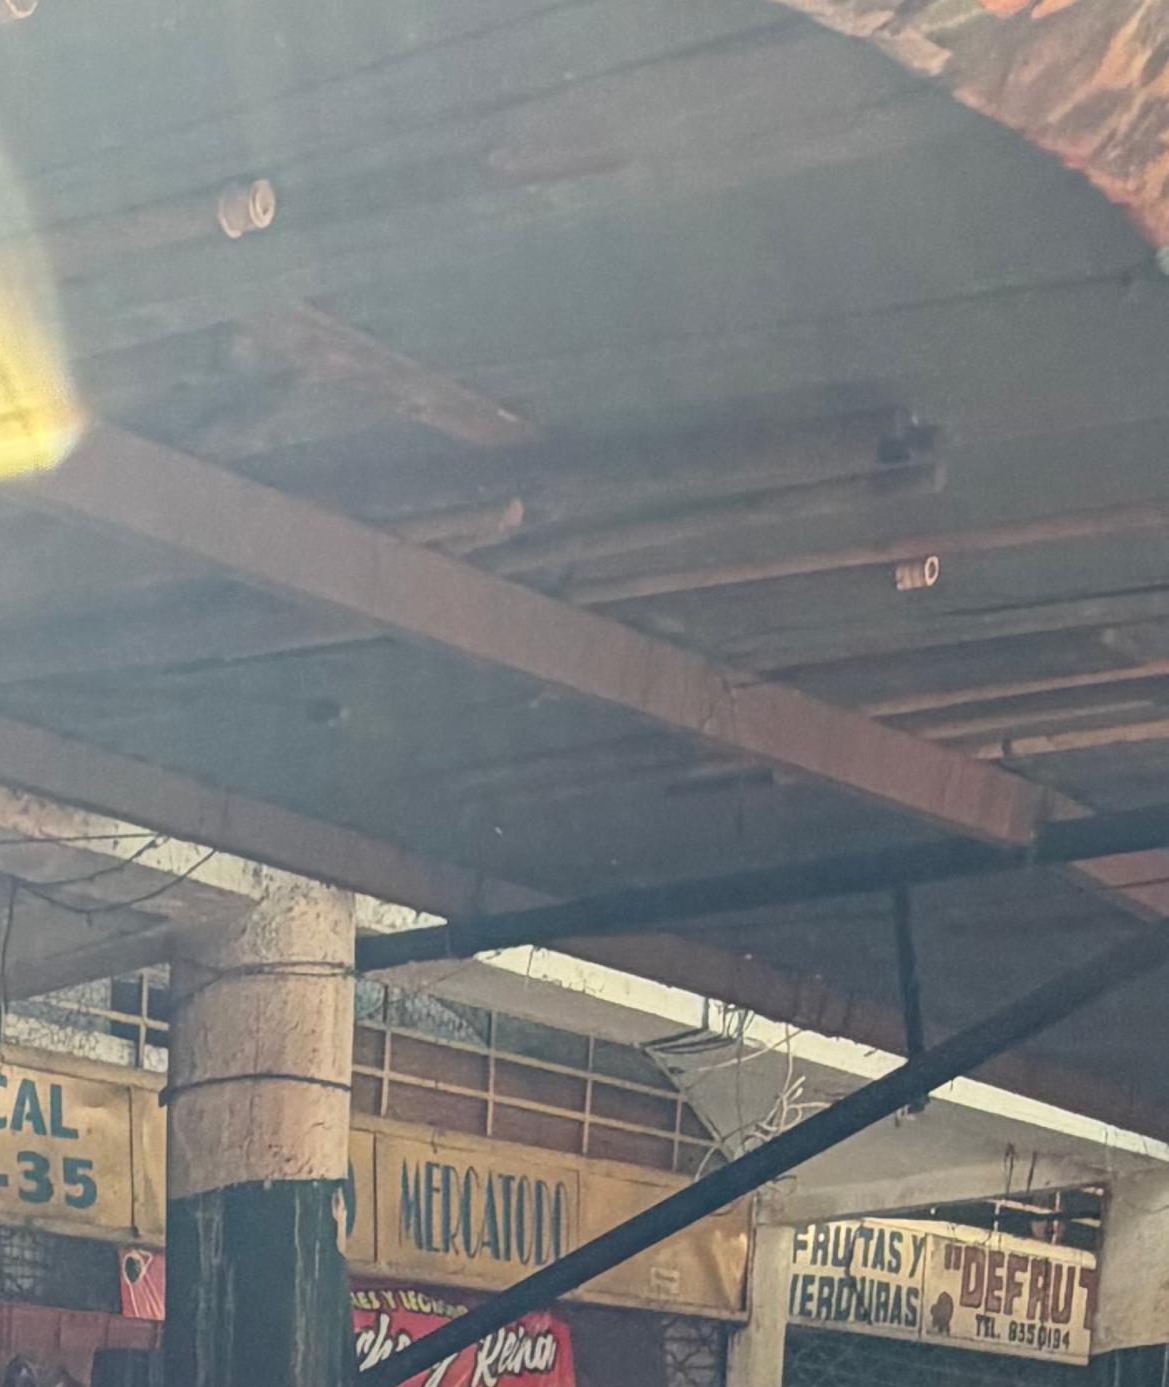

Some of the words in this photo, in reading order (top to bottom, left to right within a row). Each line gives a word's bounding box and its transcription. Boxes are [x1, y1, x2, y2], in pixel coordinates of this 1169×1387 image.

[398, 1157, 571, 1266] MERCATODO
[792, 1224, 904, 1274] FRUTAS
[909, 1233, 927, 1278] Y
[975, 1313, 1000, 1339] TEL.
